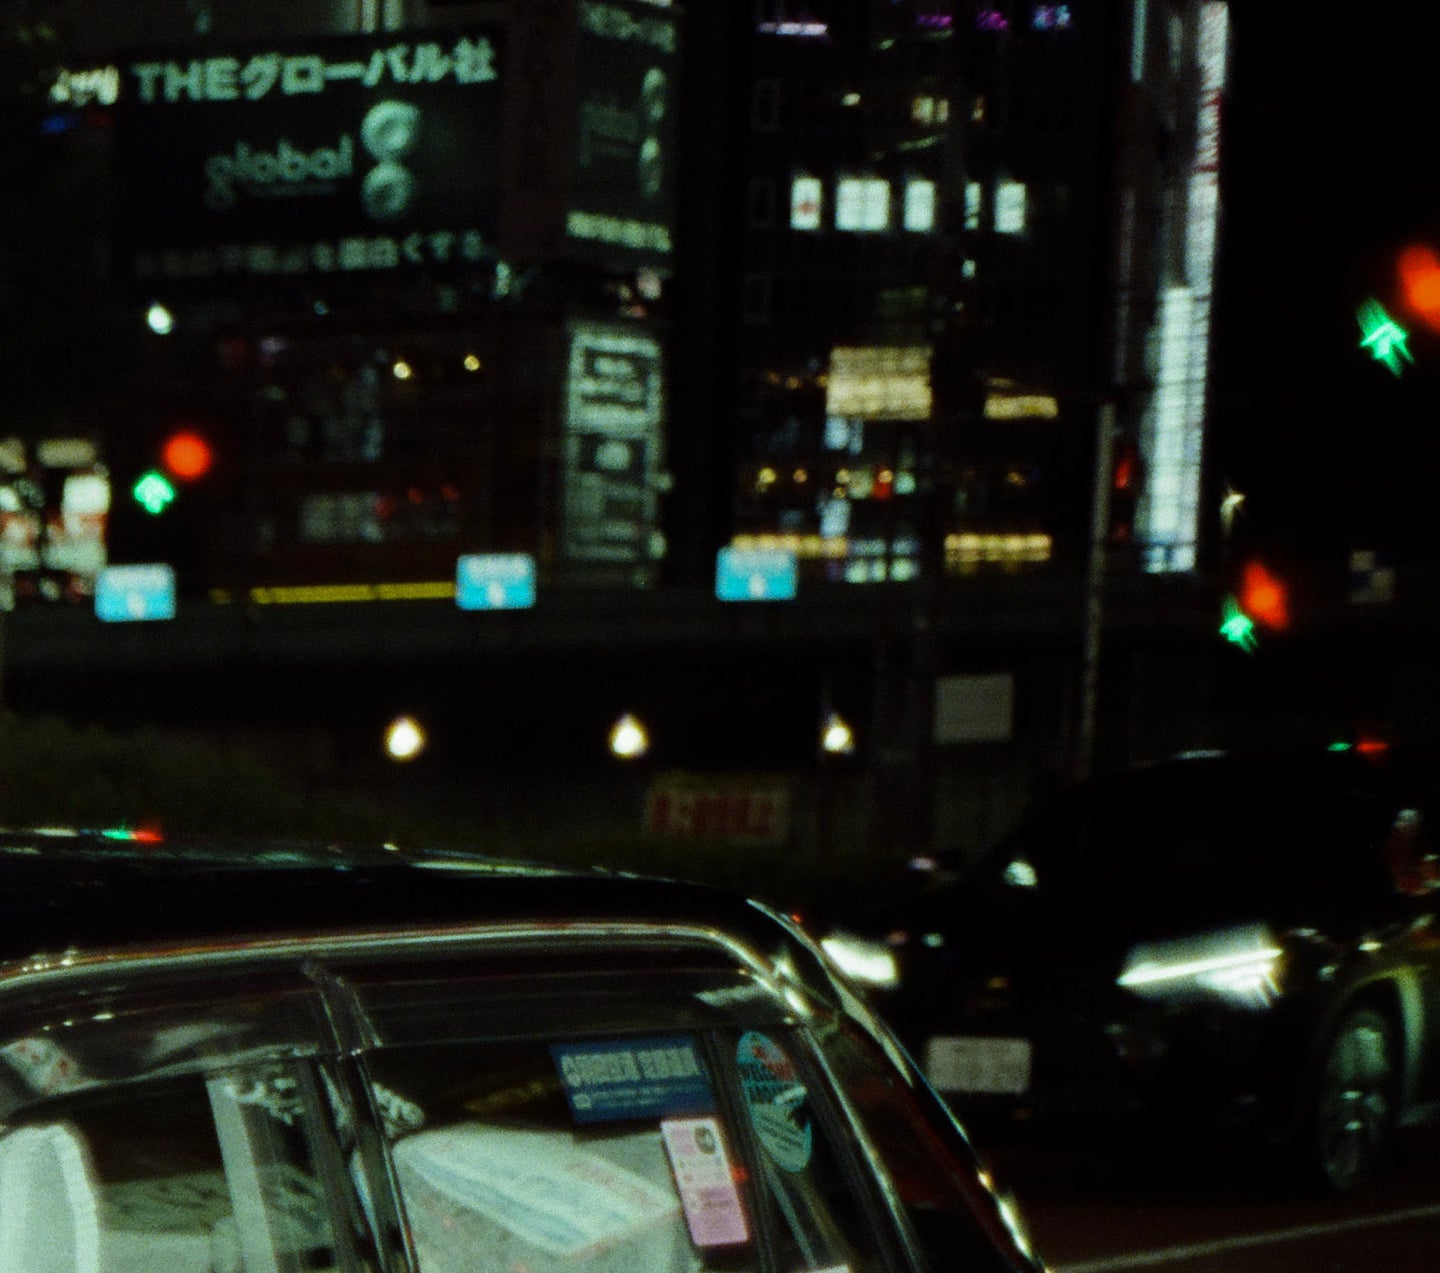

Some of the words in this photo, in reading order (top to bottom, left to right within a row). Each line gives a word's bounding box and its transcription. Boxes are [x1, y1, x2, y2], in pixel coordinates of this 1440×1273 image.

[133, 36, 497, 103] THEグローバル社
[203, 135, 353, 211] global
